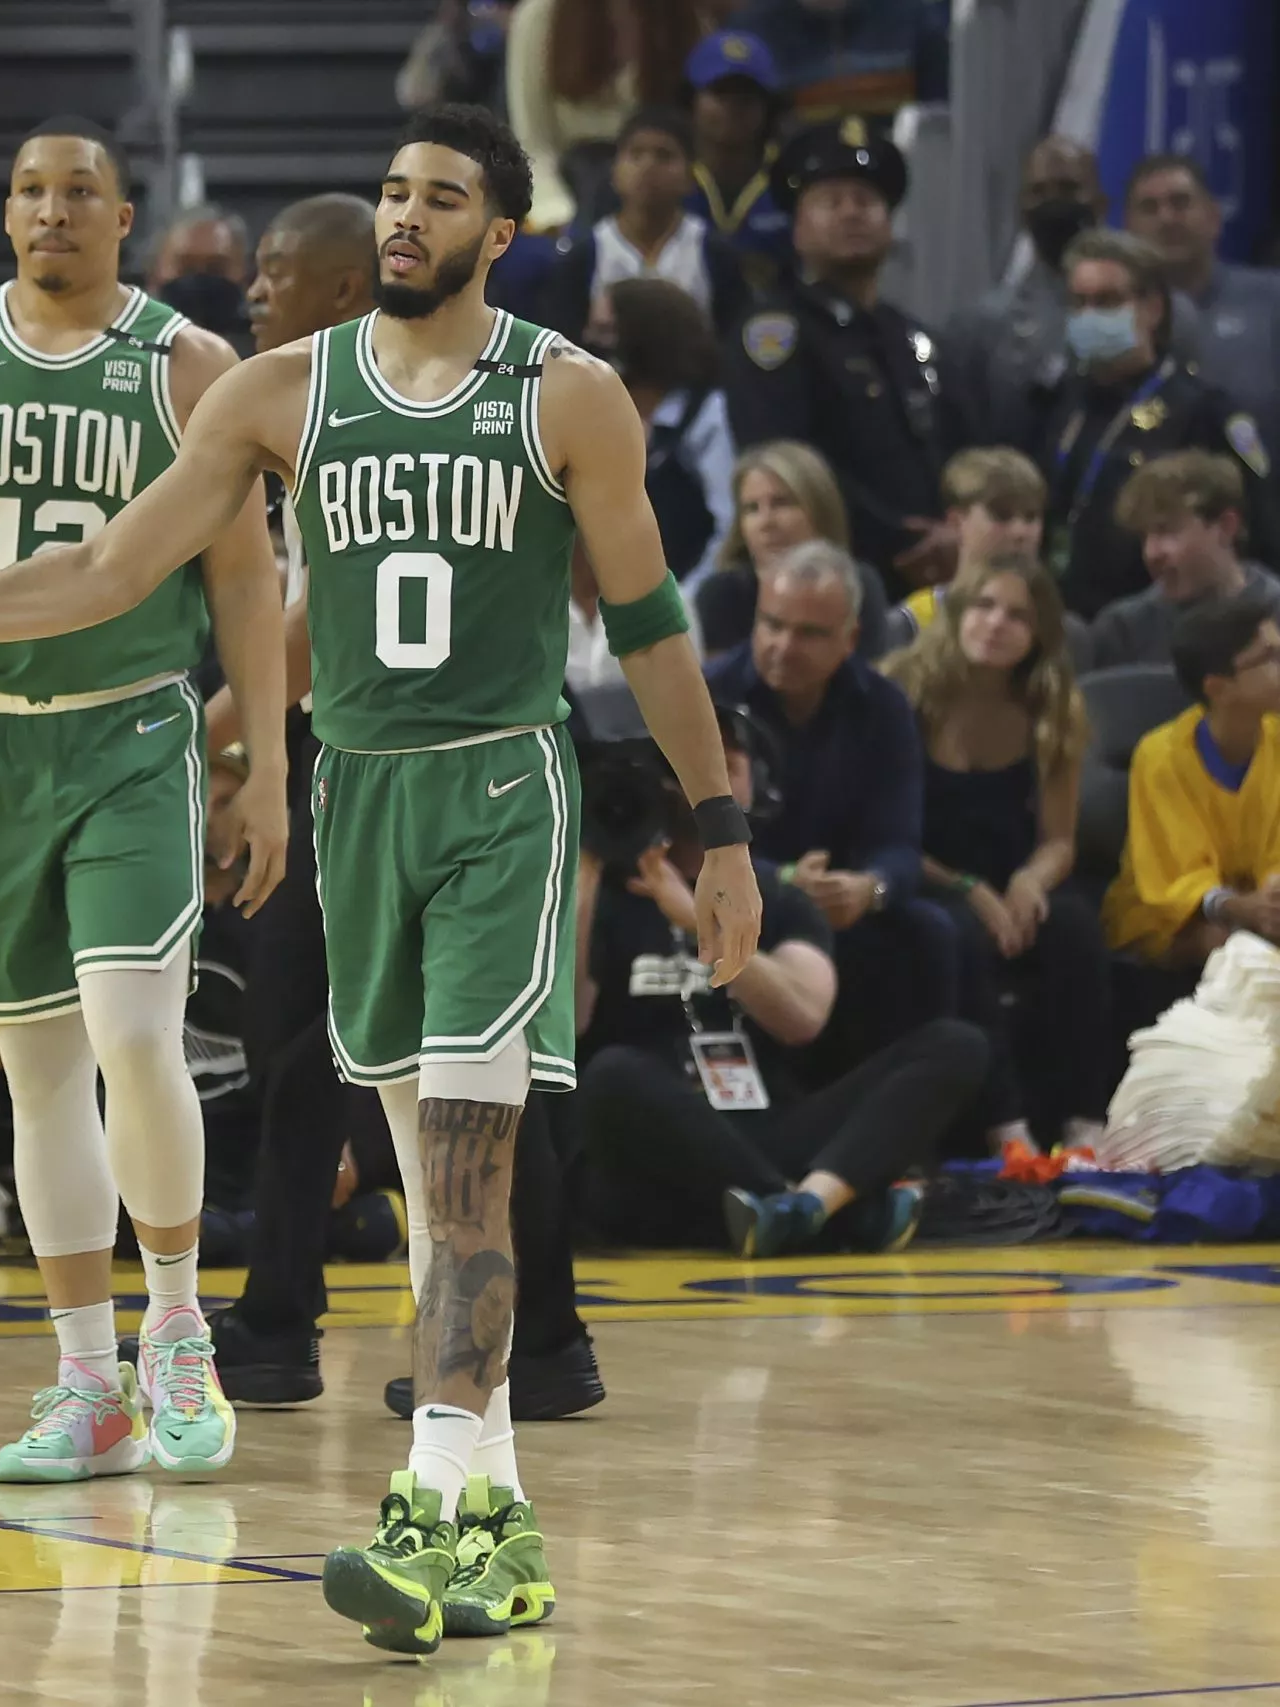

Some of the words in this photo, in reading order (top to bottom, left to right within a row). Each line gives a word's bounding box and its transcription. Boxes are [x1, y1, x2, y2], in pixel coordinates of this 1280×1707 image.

[104, 360, 142, 380] VISTA
[497, 363, 515, 376] 24
[102, 377, 141, 394] PRINT
[473, 401, 514, 420] VISTA
[472, 420, 514, 435] PRINT
[319, 453, 523, 553] BOSTON
[375, 552, 453, 669] 0
